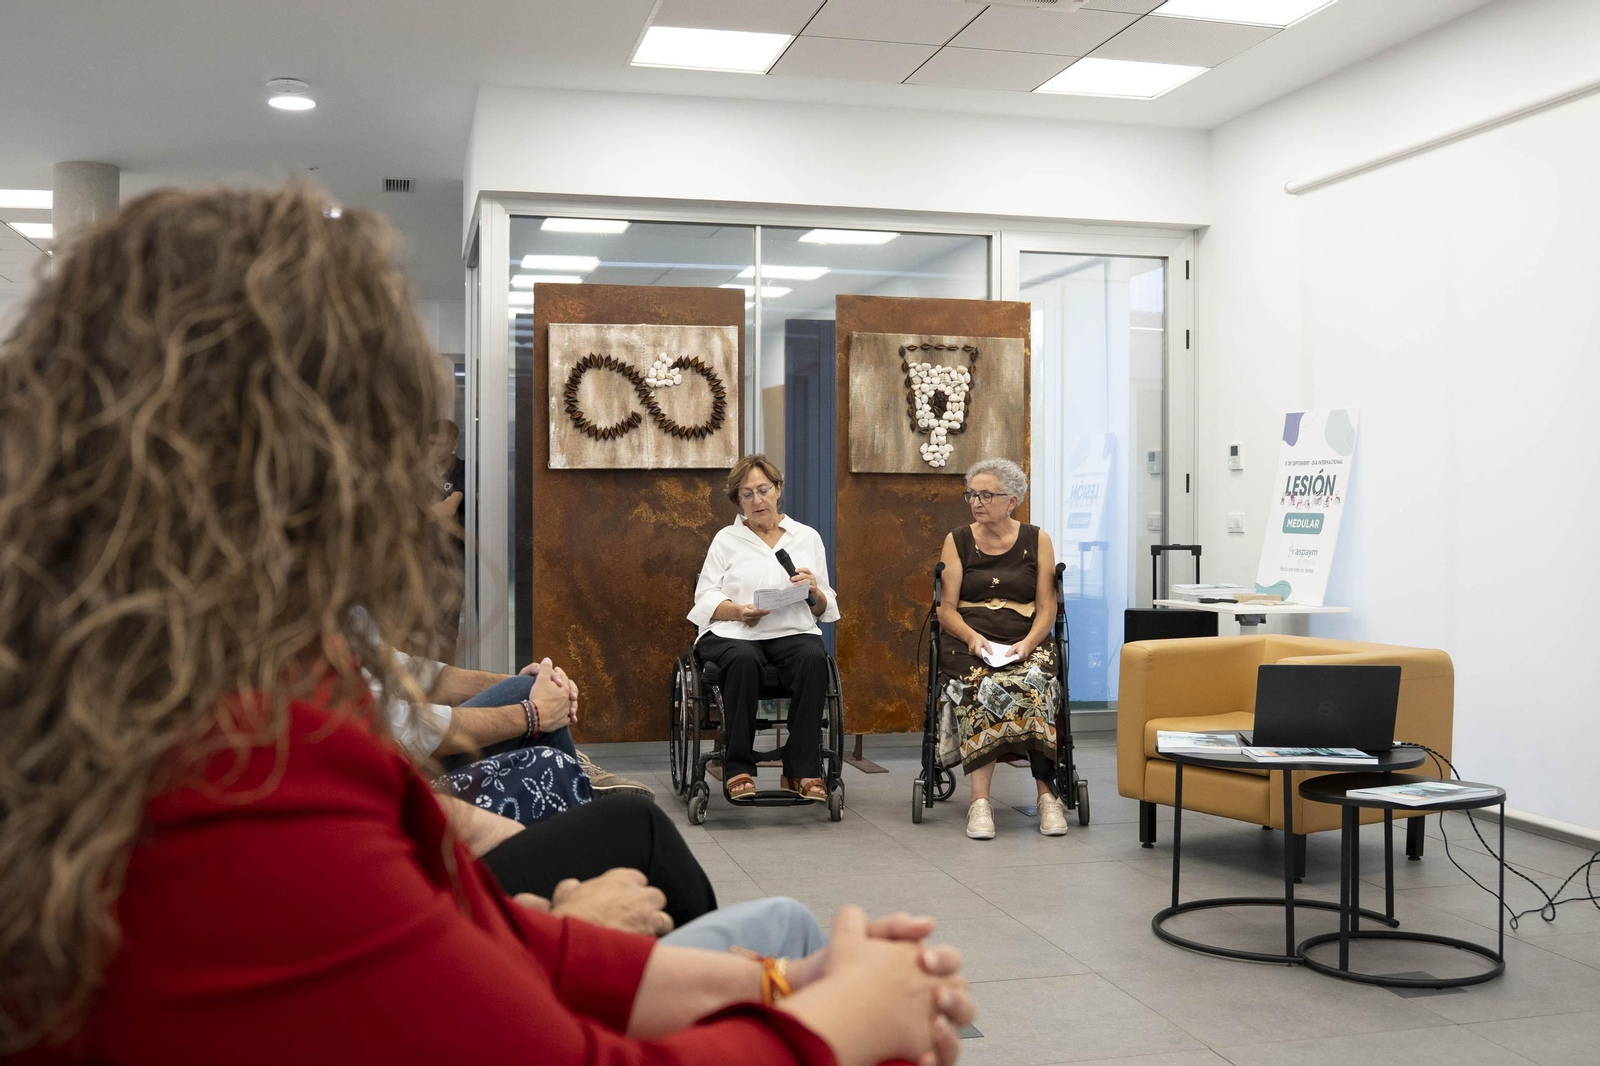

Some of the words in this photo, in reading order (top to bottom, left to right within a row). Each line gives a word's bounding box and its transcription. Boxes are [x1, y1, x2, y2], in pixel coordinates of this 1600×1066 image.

[1285, 468, 1336, 496] LESIÓN
[1286, 518, 1320, 528] MEDULAR
[1295, 548, 1318, 557] aspaym
